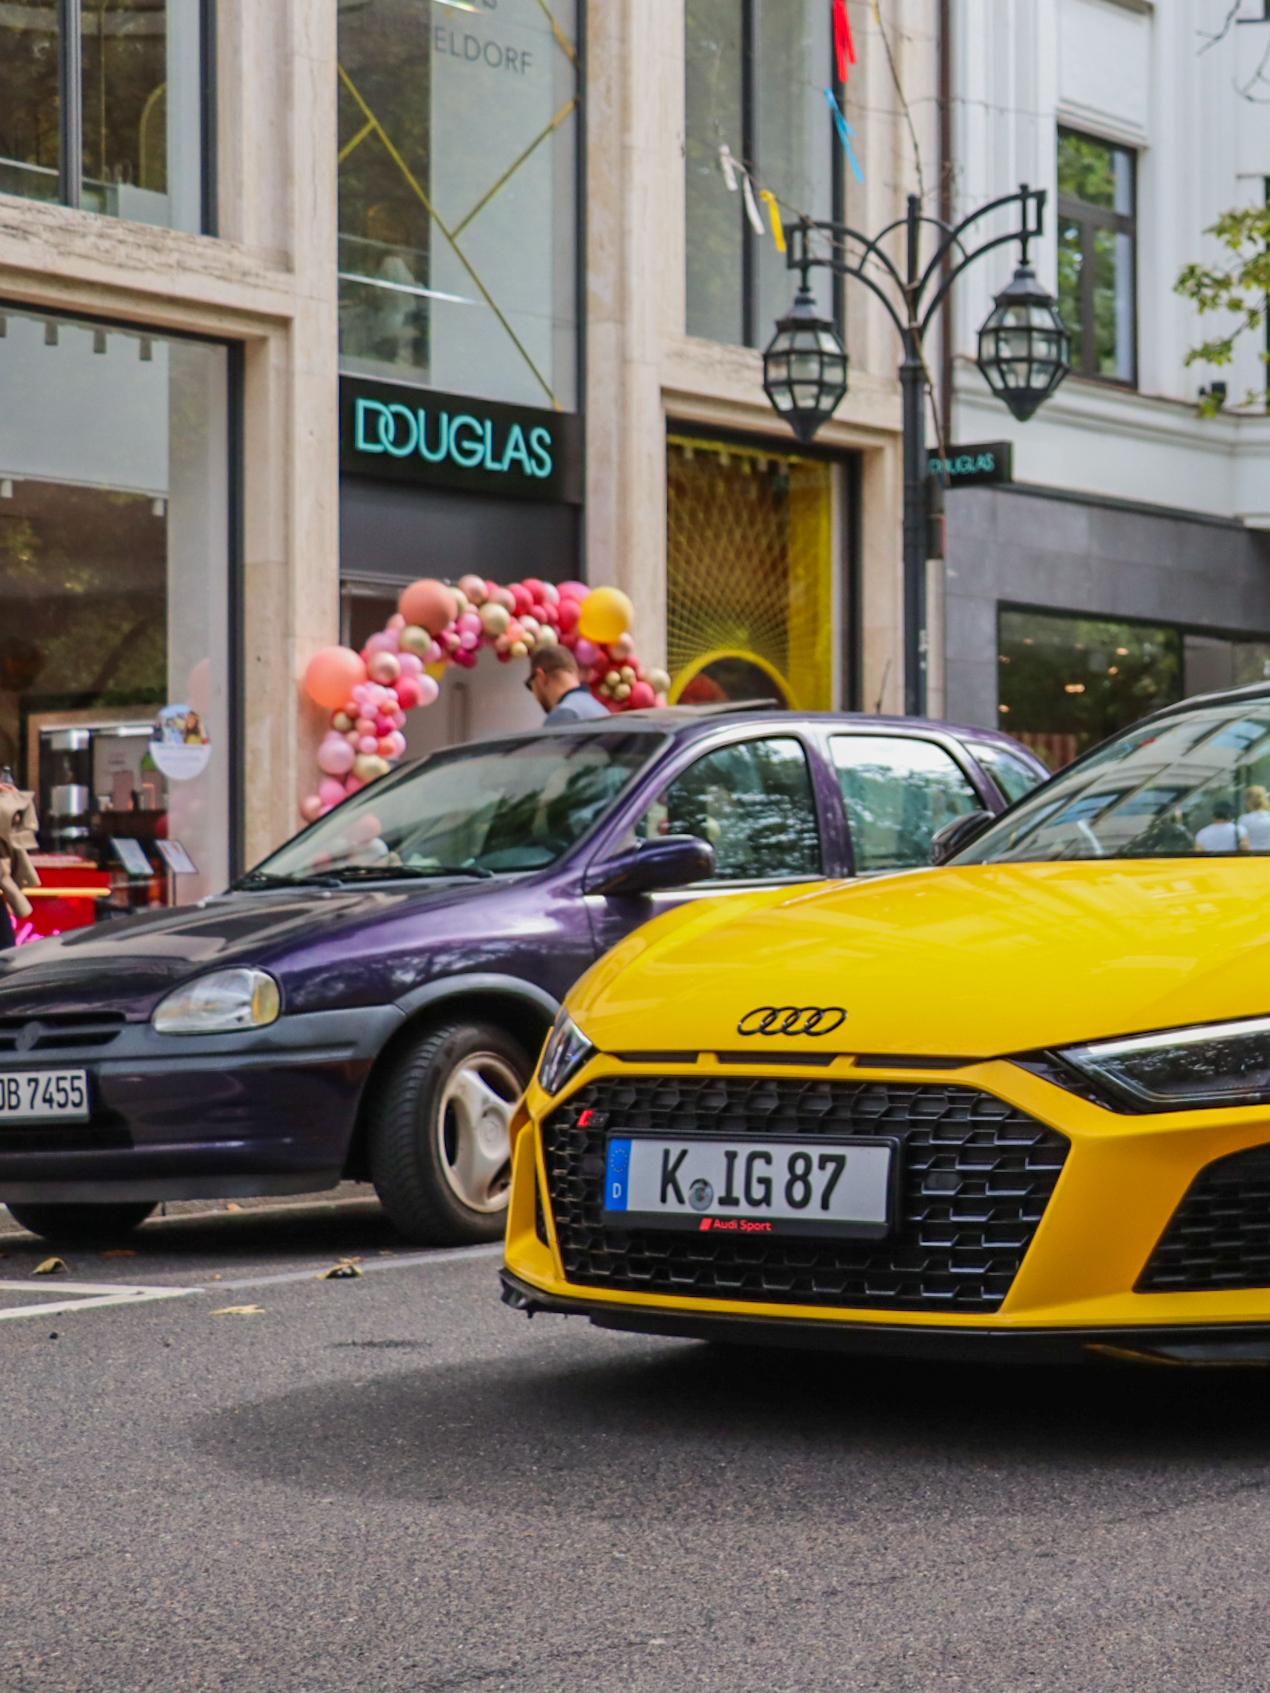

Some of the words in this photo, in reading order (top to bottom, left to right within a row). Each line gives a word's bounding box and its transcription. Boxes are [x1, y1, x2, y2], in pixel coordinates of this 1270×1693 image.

[355, 398, 553, 478] DOUGLAS
[27, 1075, 84, 1109] 7455
[612, 1183, 622, 1199] D
[660, 1148, 689, 1205] K
[717, 1150, 773, 1208] IG
[784, 1151, 847, 1212] 87
[713, 1218, 738, 1230] Audi
[740, 1219, 772, 1233] Sport
